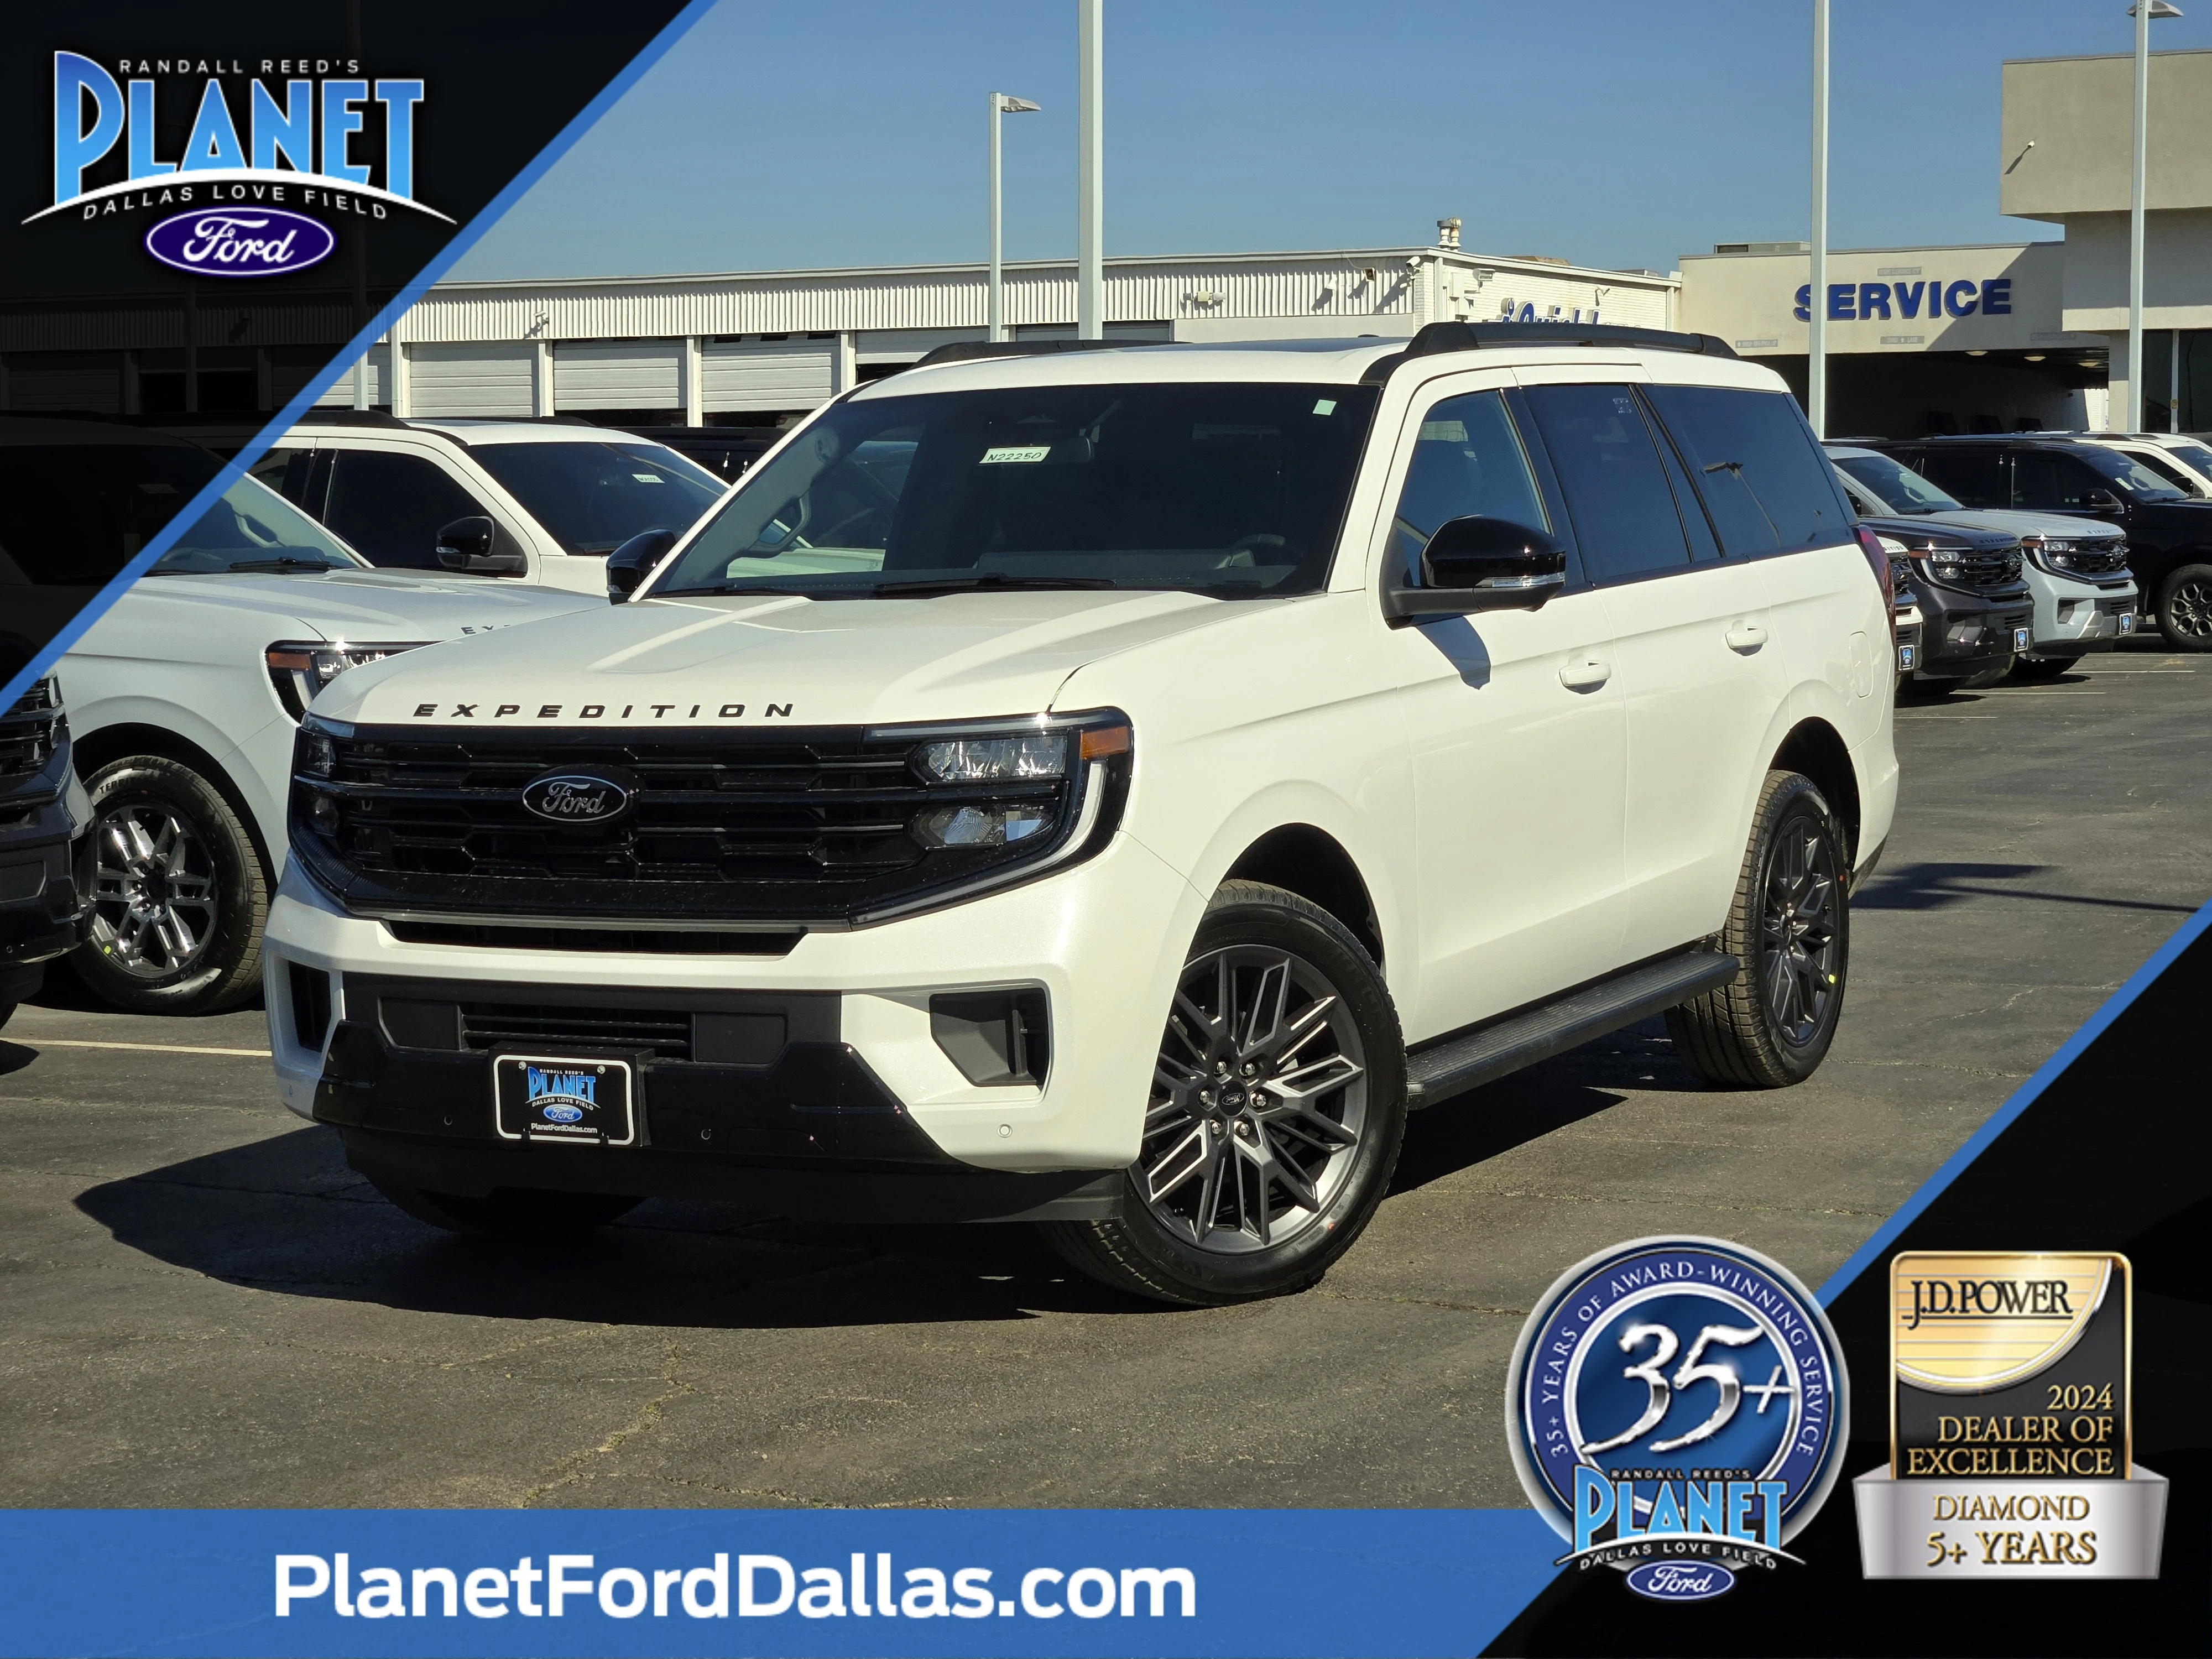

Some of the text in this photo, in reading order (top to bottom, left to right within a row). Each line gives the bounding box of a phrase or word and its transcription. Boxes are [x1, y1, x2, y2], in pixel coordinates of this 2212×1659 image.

[1793, 279, 2011, 322] SERVICE
[987, 452, 1041, 461] N22250
[414, 703, 794, 719] EXPEDITION
[542, 781, 606, 814] Ford
[528, 1066, 596, 1103] PLANET
[532, 1098, 555, 1107] DALLAS
[576, 1100, 594, 1111] FIELD
[551, 1107, 575, 1120] Ford
[531, 1123, 598, 1134] PlanetFordDallas.com
